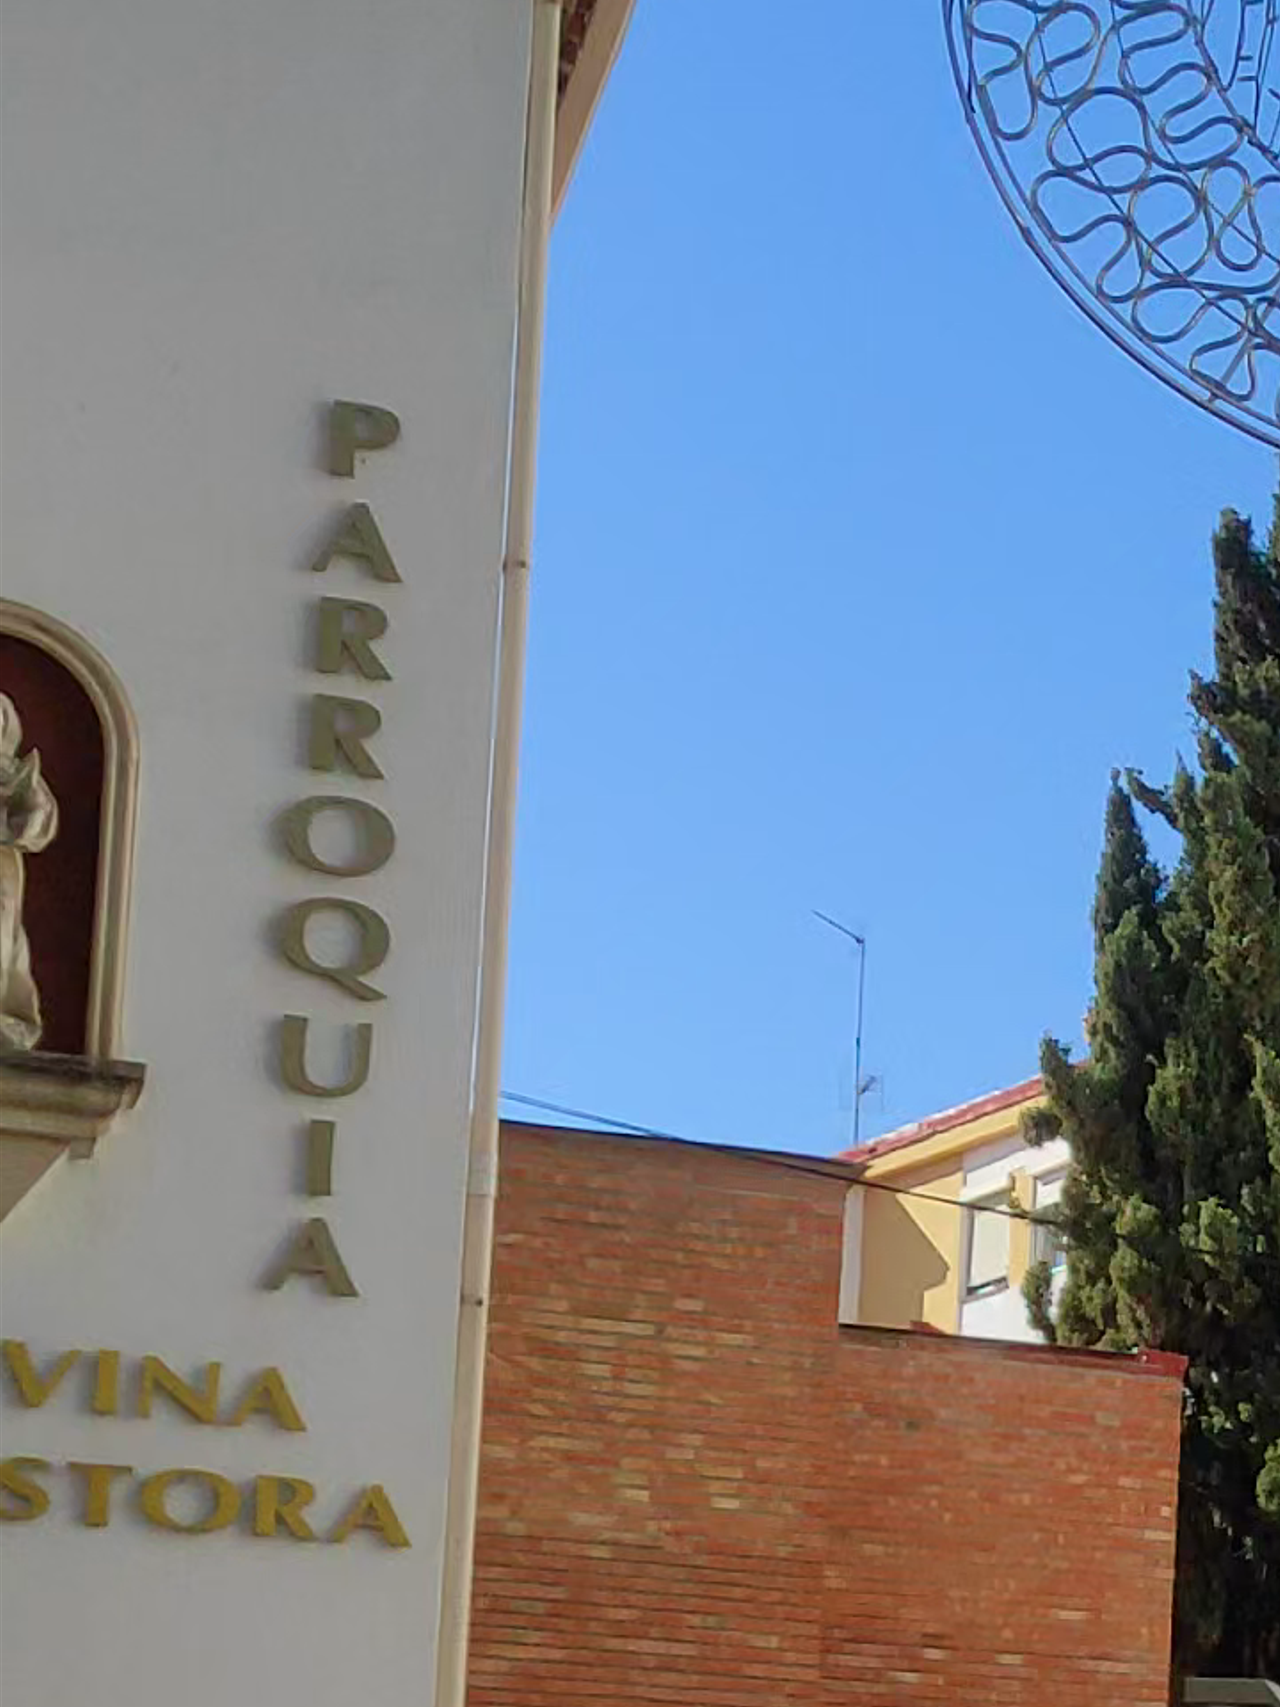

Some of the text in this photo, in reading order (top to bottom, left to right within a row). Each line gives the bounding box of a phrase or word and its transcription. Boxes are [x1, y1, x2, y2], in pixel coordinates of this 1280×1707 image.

[269, 397, 402, 1299] PARROQUIA
[1, 1339, 308, 1432] VINA
[0, 1456, 412, 1548] STORA
